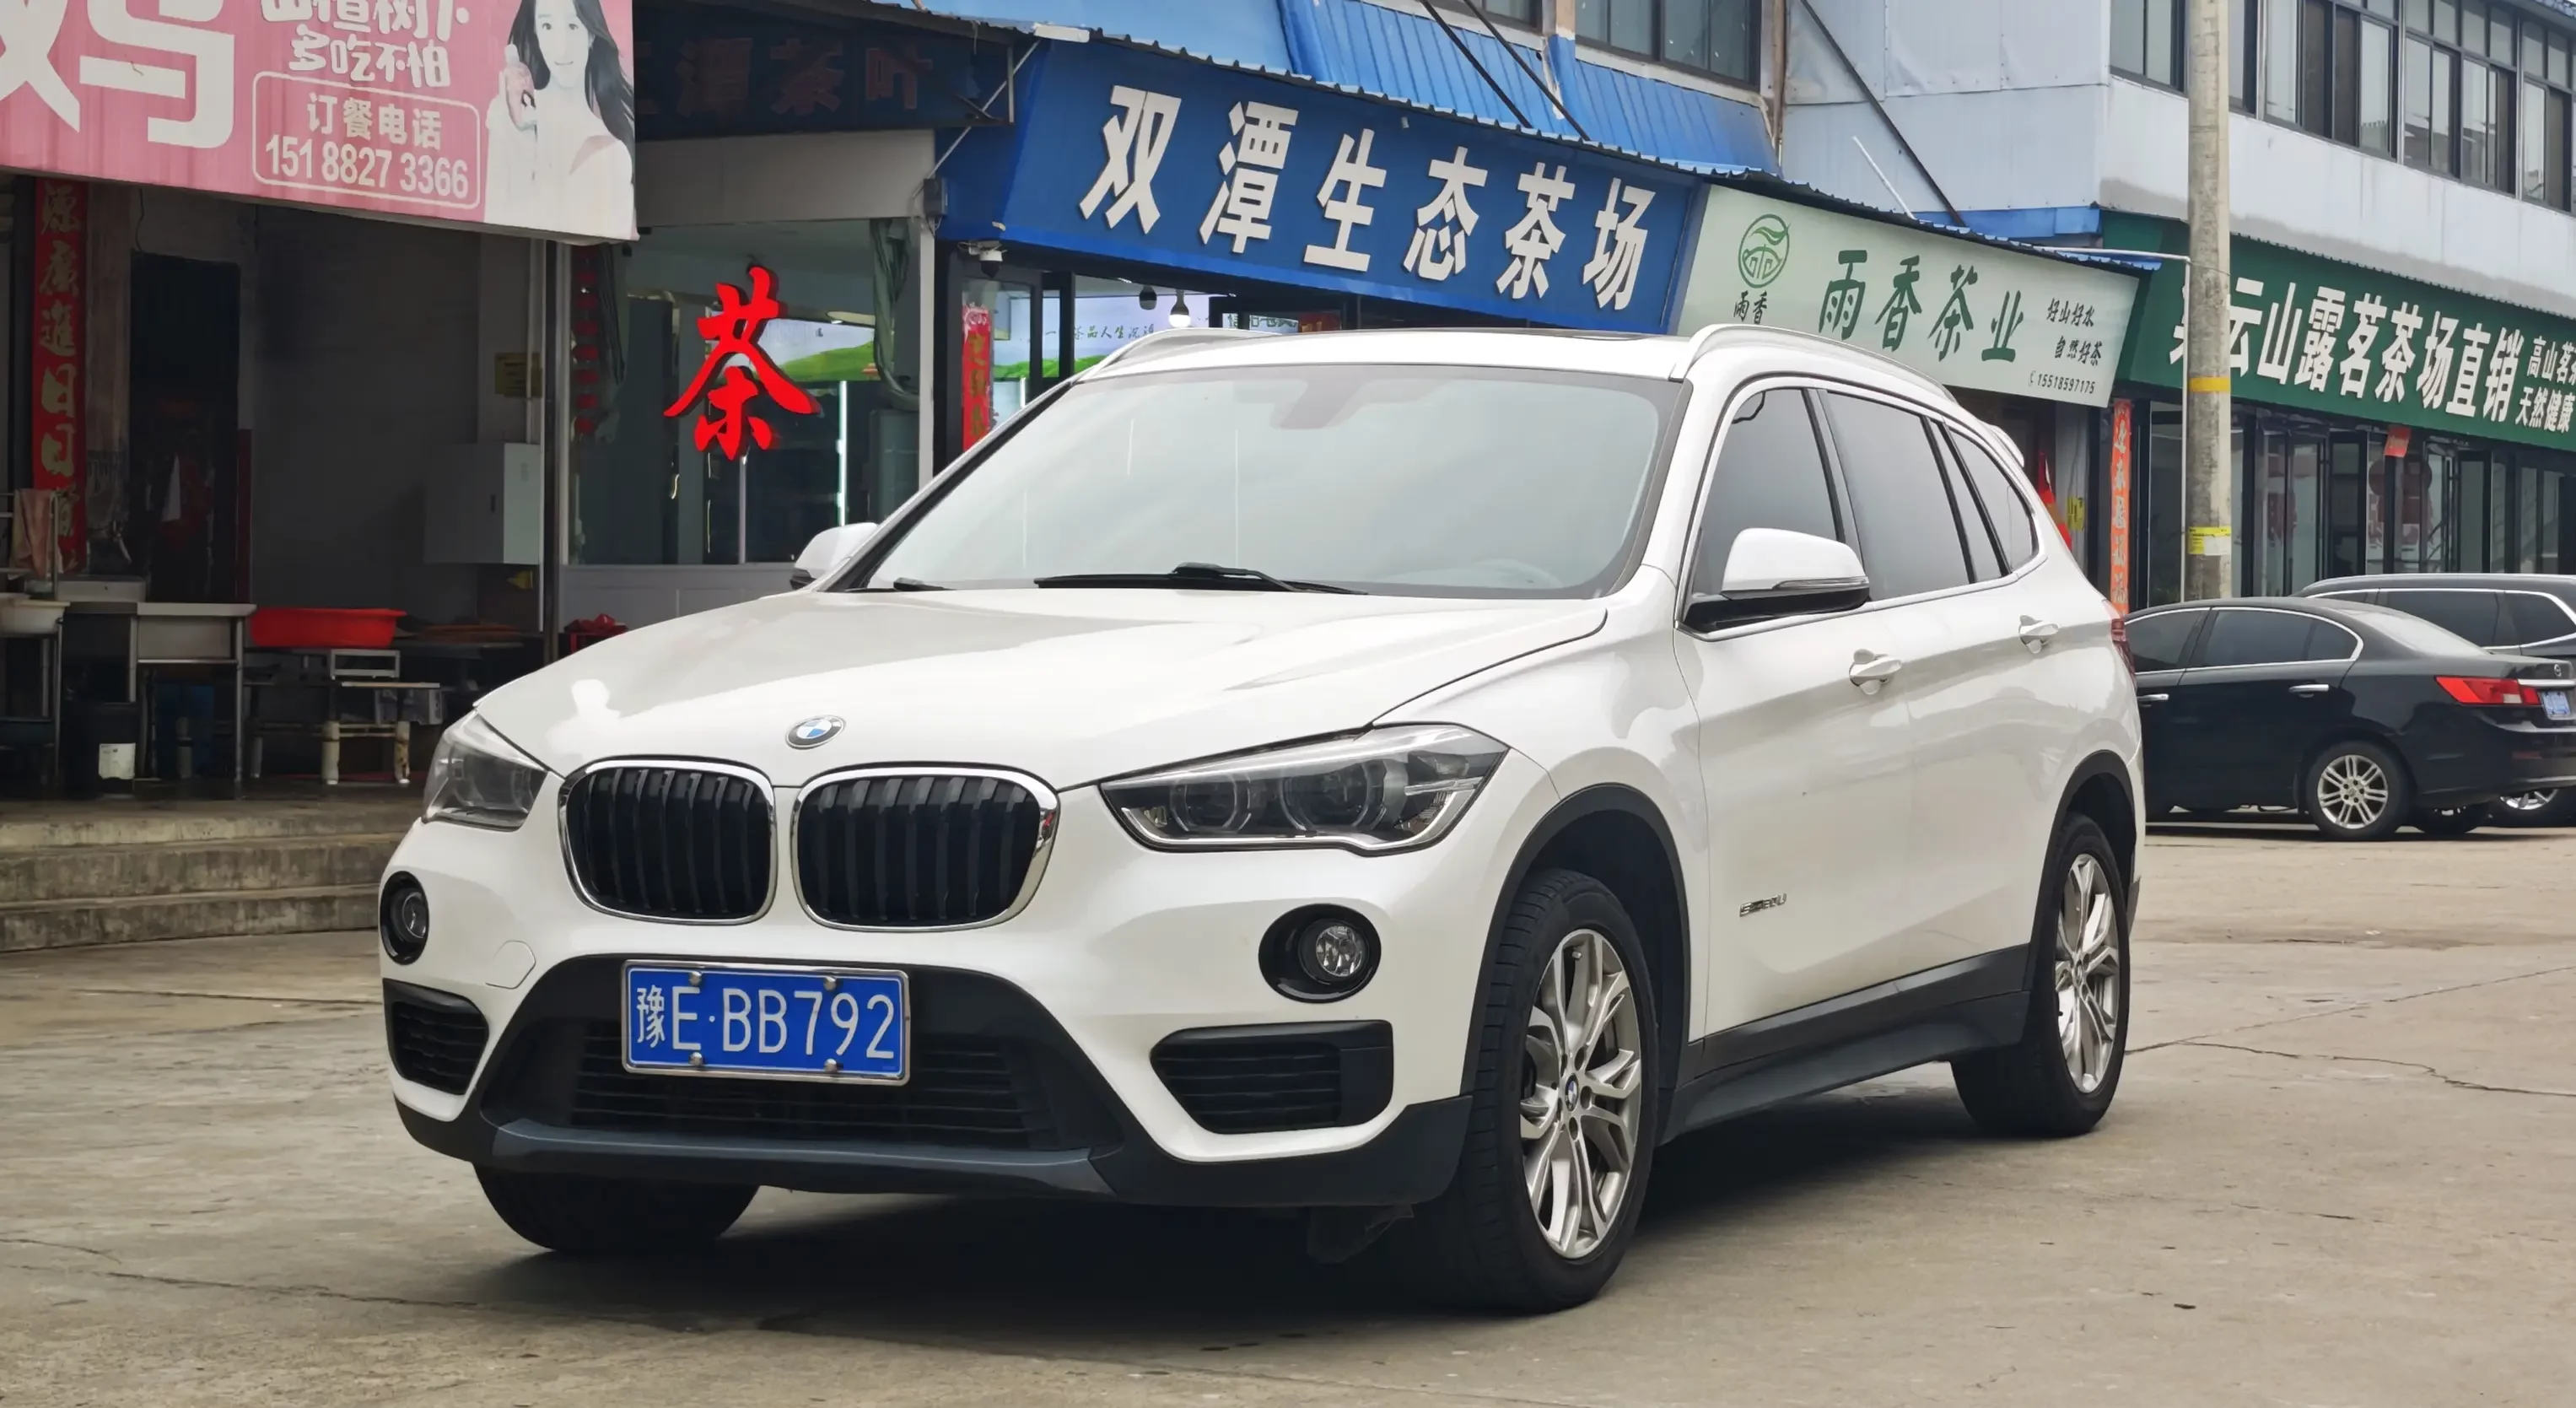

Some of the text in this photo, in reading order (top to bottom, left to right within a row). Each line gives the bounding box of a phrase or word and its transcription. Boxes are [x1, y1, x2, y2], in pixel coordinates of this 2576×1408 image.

[288, 24, 451, 88] 多吃不怕
[634, 36, 934, 118] 潭茶叶
[307, 92, 442, 150] 订餐电话
[400, 152, 468, 199] 3366
[1080, 85, 1656, 310] 双潭生态茶场
[1733, 290, 1768, 325] 雨香
[1818, 250, 2024, 362] 雨香茶业
[2046, 297, 2095, 327] 好山好水
[664, 267, 821, 460] 茶
[2055, 336, 2103, 366] 自然好茶
[2169, 277, 2525, 422] 云山露茗茶场直销
[2037, 373, 2096, 394] 15518597175
[2515, 386, 2576, 433] 天然健康
